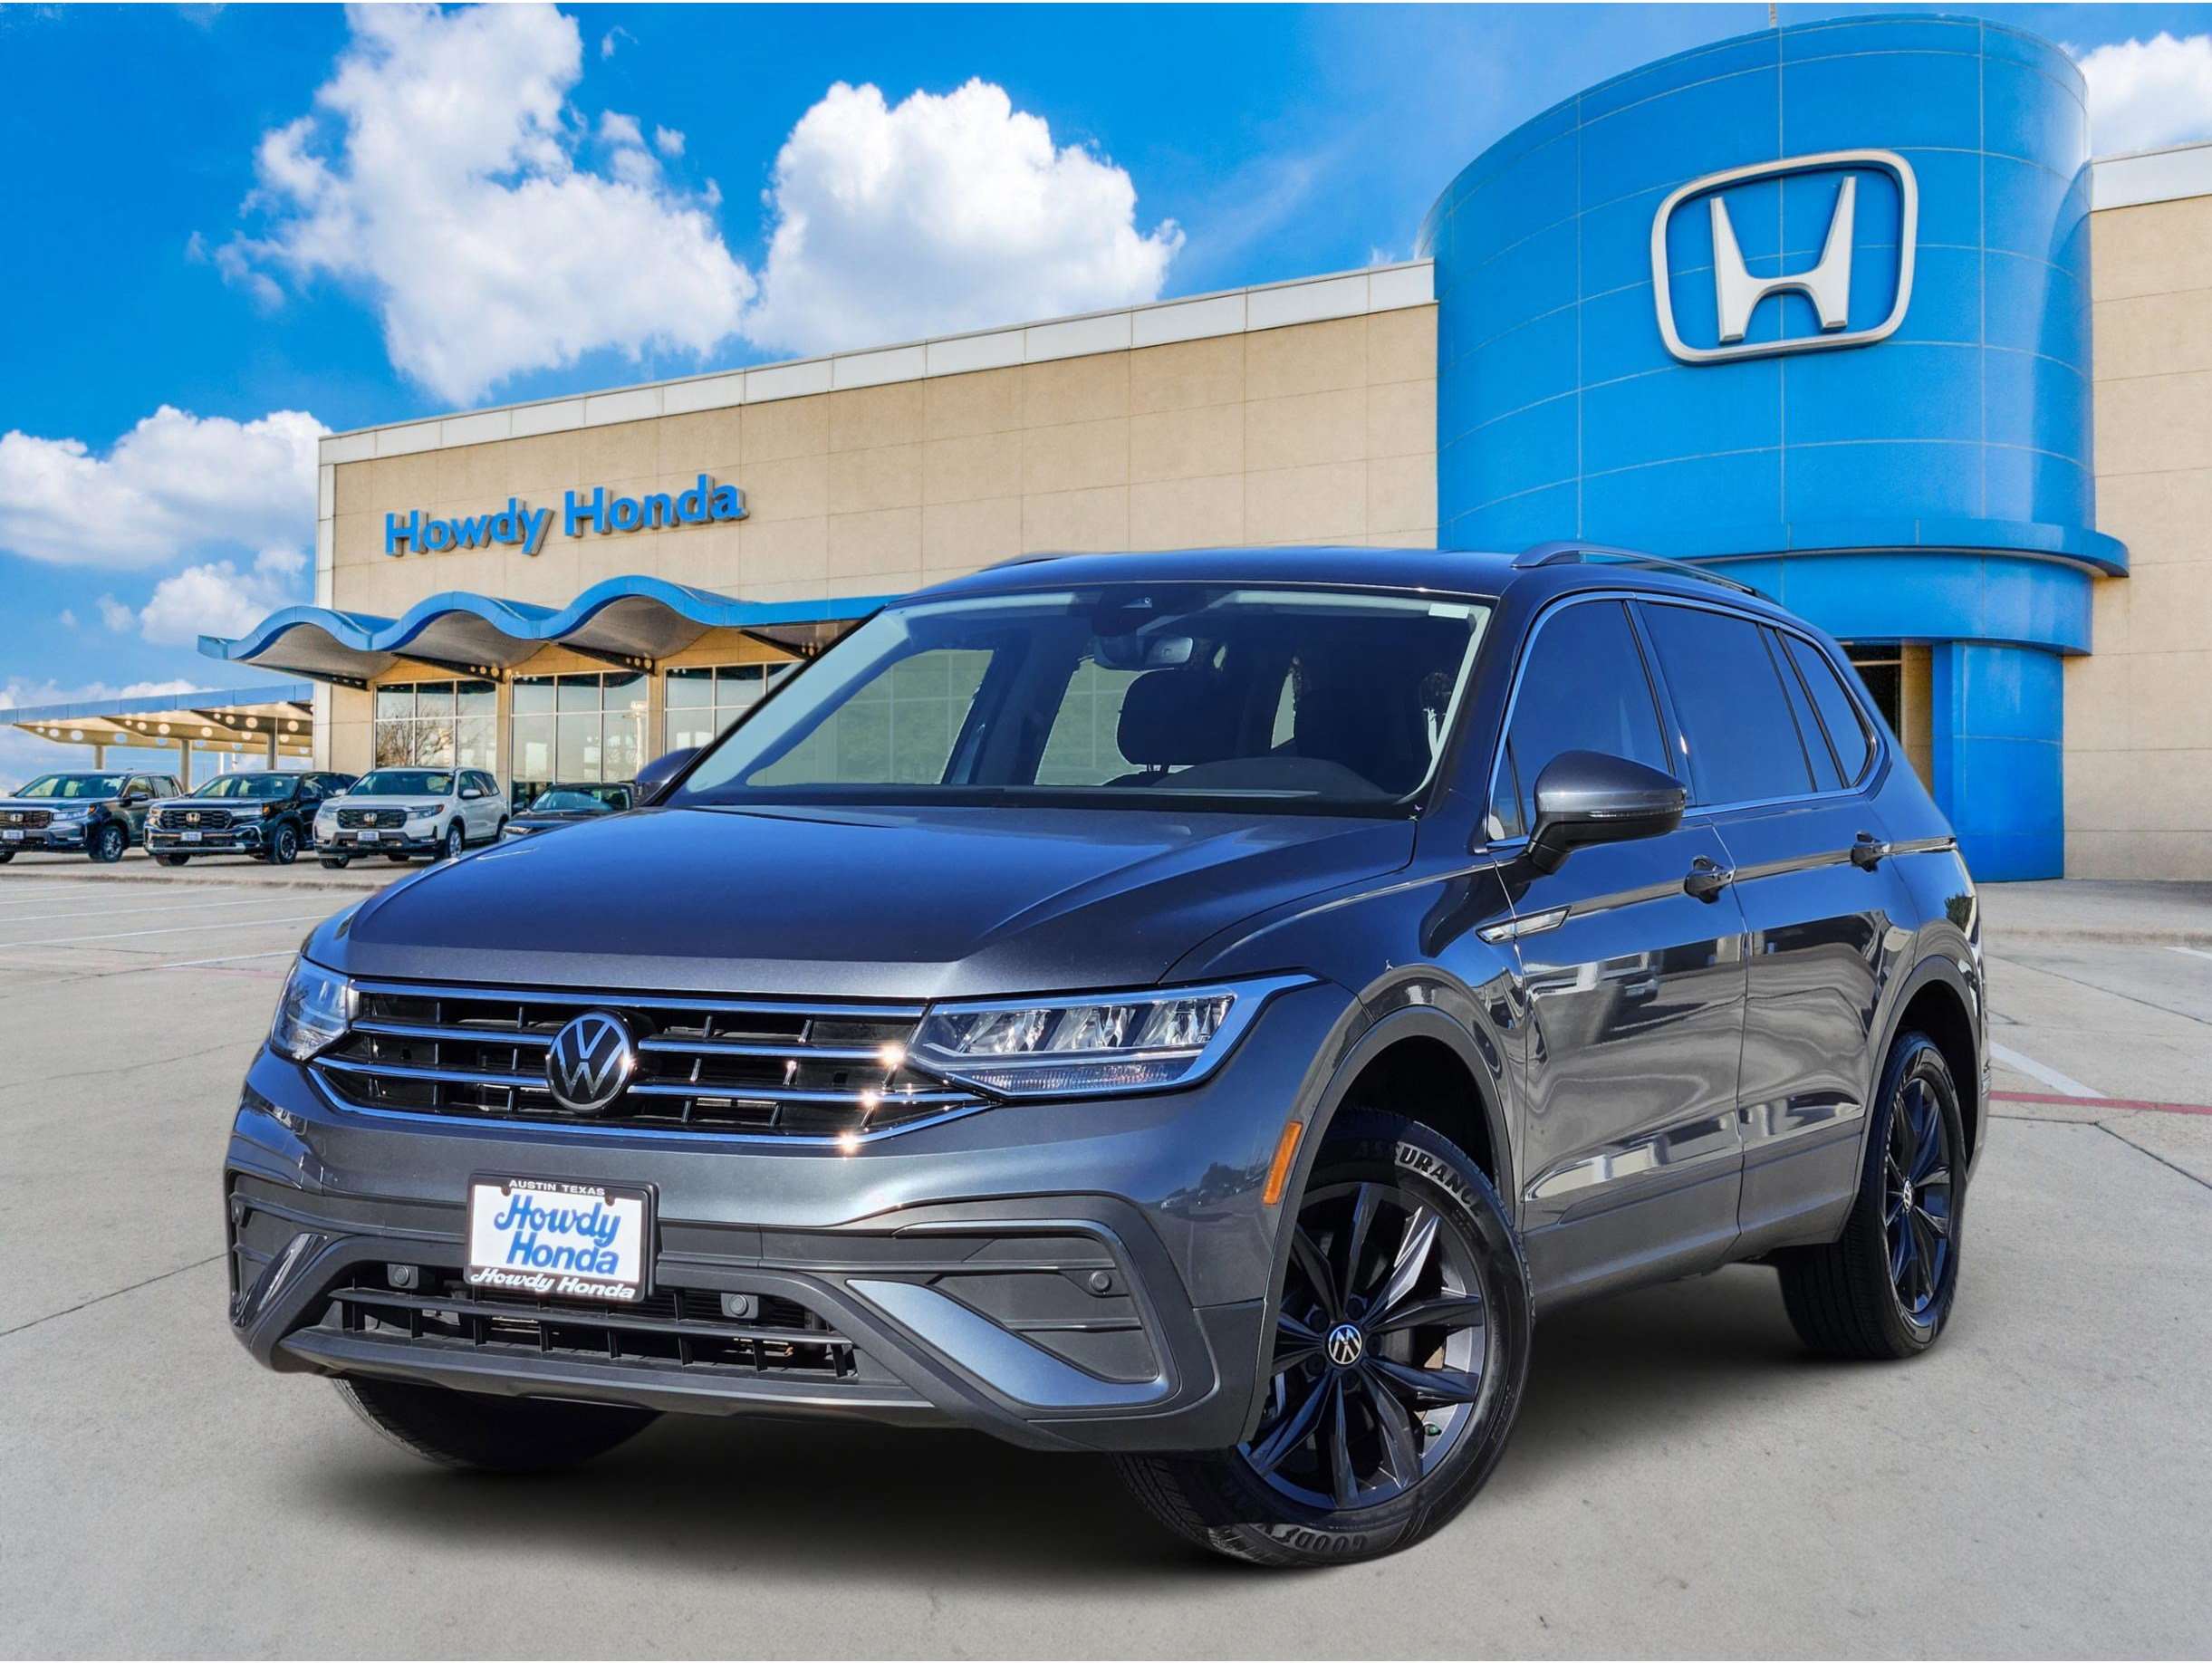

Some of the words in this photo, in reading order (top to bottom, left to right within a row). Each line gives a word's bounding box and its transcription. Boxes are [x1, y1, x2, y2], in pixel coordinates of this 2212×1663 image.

[385, 497, 554, 556] Howdy
[564, 474, 748, 538] Honda
[508, 1179, 556, 1192] AUSTIN
[561, 1184, 605, 1197] TEXAS
[494, 1194, 621, 1248] Howdy
[506, 1230, 620, 1275] Honda
[470, 1268, 556, 1292] Howdy
[556, 1277, 635, 1299] Honda
